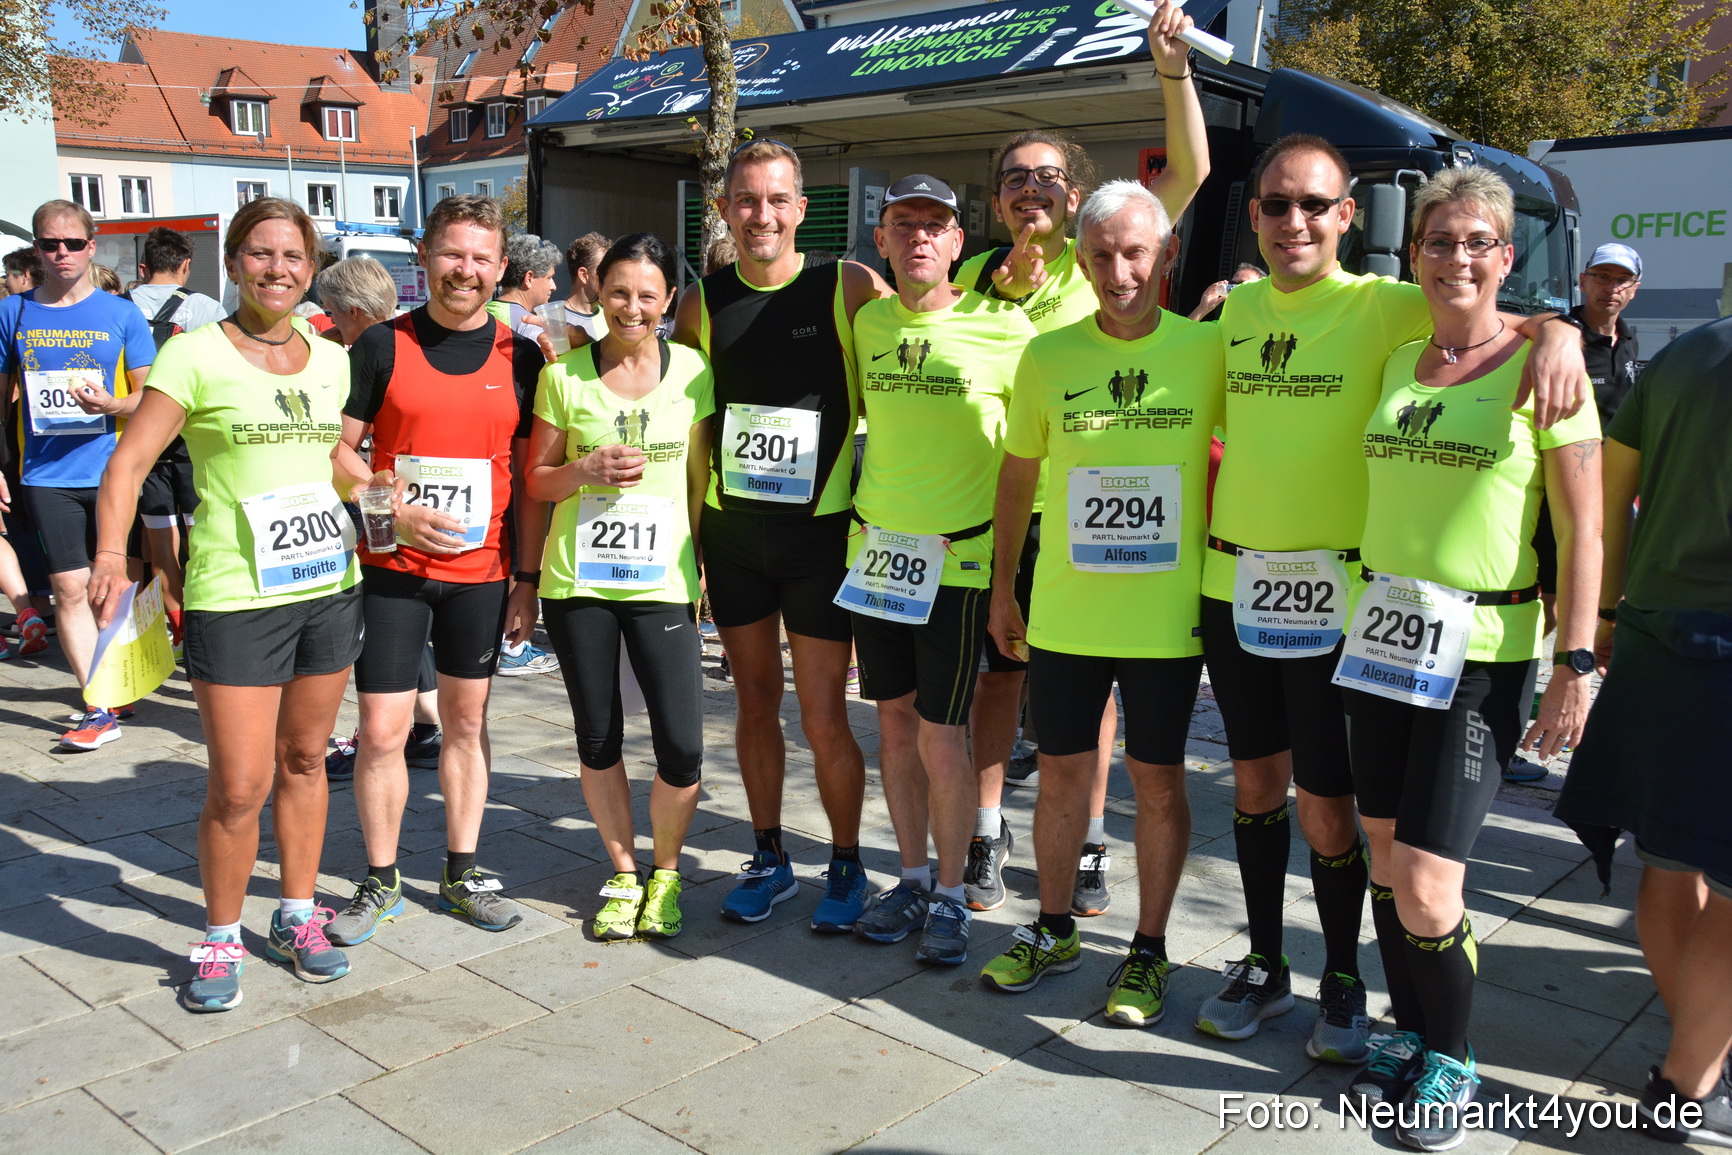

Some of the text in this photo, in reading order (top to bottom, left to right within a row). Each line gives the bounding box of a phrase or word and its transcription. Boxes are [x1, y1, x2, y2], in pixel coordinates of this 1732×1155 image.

[827, 7, 1017, 54] Willkommen
[1014, 11, 1035, 20] IN
[1035, 5, 1071, 17] DER
[861, 17, 1057, 58] NEUMARKTER
[851, 39, 1022, 77] LIMOKÜCHE
[1610, 210, 1726, 239] OFFICE
[27, 329, 110, 341] NEUMARKTER
[792, 325, 817, 336] GORE
[25, 338, 94, 348] STADTLAUF
[750, 414, 791, 428] BOCK
[1063, 411, 1080, 420] SC
[232, 421, 342, 432] SC OBERÖLSBA
[576, 444, 590, 453] SC
[734, 431, 799, 464] 2301
[1364, 445, 1496, 472] AUFTREFF
[420, 465, 463, 477] BOCK
[739, 463, 787, 474] PARTL Neumarkt
[747, 476, 783, 494] Ronny
[1101, 476, 1150, 488] BOCK
[406, 482, 471, 514] 2571
[1085, 496, 1165, 529] 2294
[269, 510, 341, 551] 2300
[591, 520, 656, 550] 2211
[879, 532, 920, 549] BOCK
[281, 545, 334, 562] PARTL Neumarkt
[1104, 548, 1147, 561] Alfons
[292, 560, 337, 580] Brigitte
[611, 566, 639, 579] Ilona
[863, 549, 927, 586] 2298
[1267, 561, 1318, 573] BOCK
[865, 580, 907, 594] PARTL Neumarkt
[1251, 579, 1335, 613] 2292
[864, 593, 906, 612] Thomas
[1387, 586, 1435, 607] BOCK
[1258, 616, 1318, 626] PARTL Neumarkt
[1361, 606, 1443, 655] 2291
[1258, 631, 1322, 649] Benjamin
[1365, 646, 1423, 666] PARTL Neumarkt
[1360, 663, 1429, 692] Alexandra
[1465, 709, 1491, 759] cep
[1233, 810, 1253, 825] ep
[1318, 850, 1357, 868] cep
[1370, 887, 1393, 901] ep
[1405, 934, 1455, 952] cep
